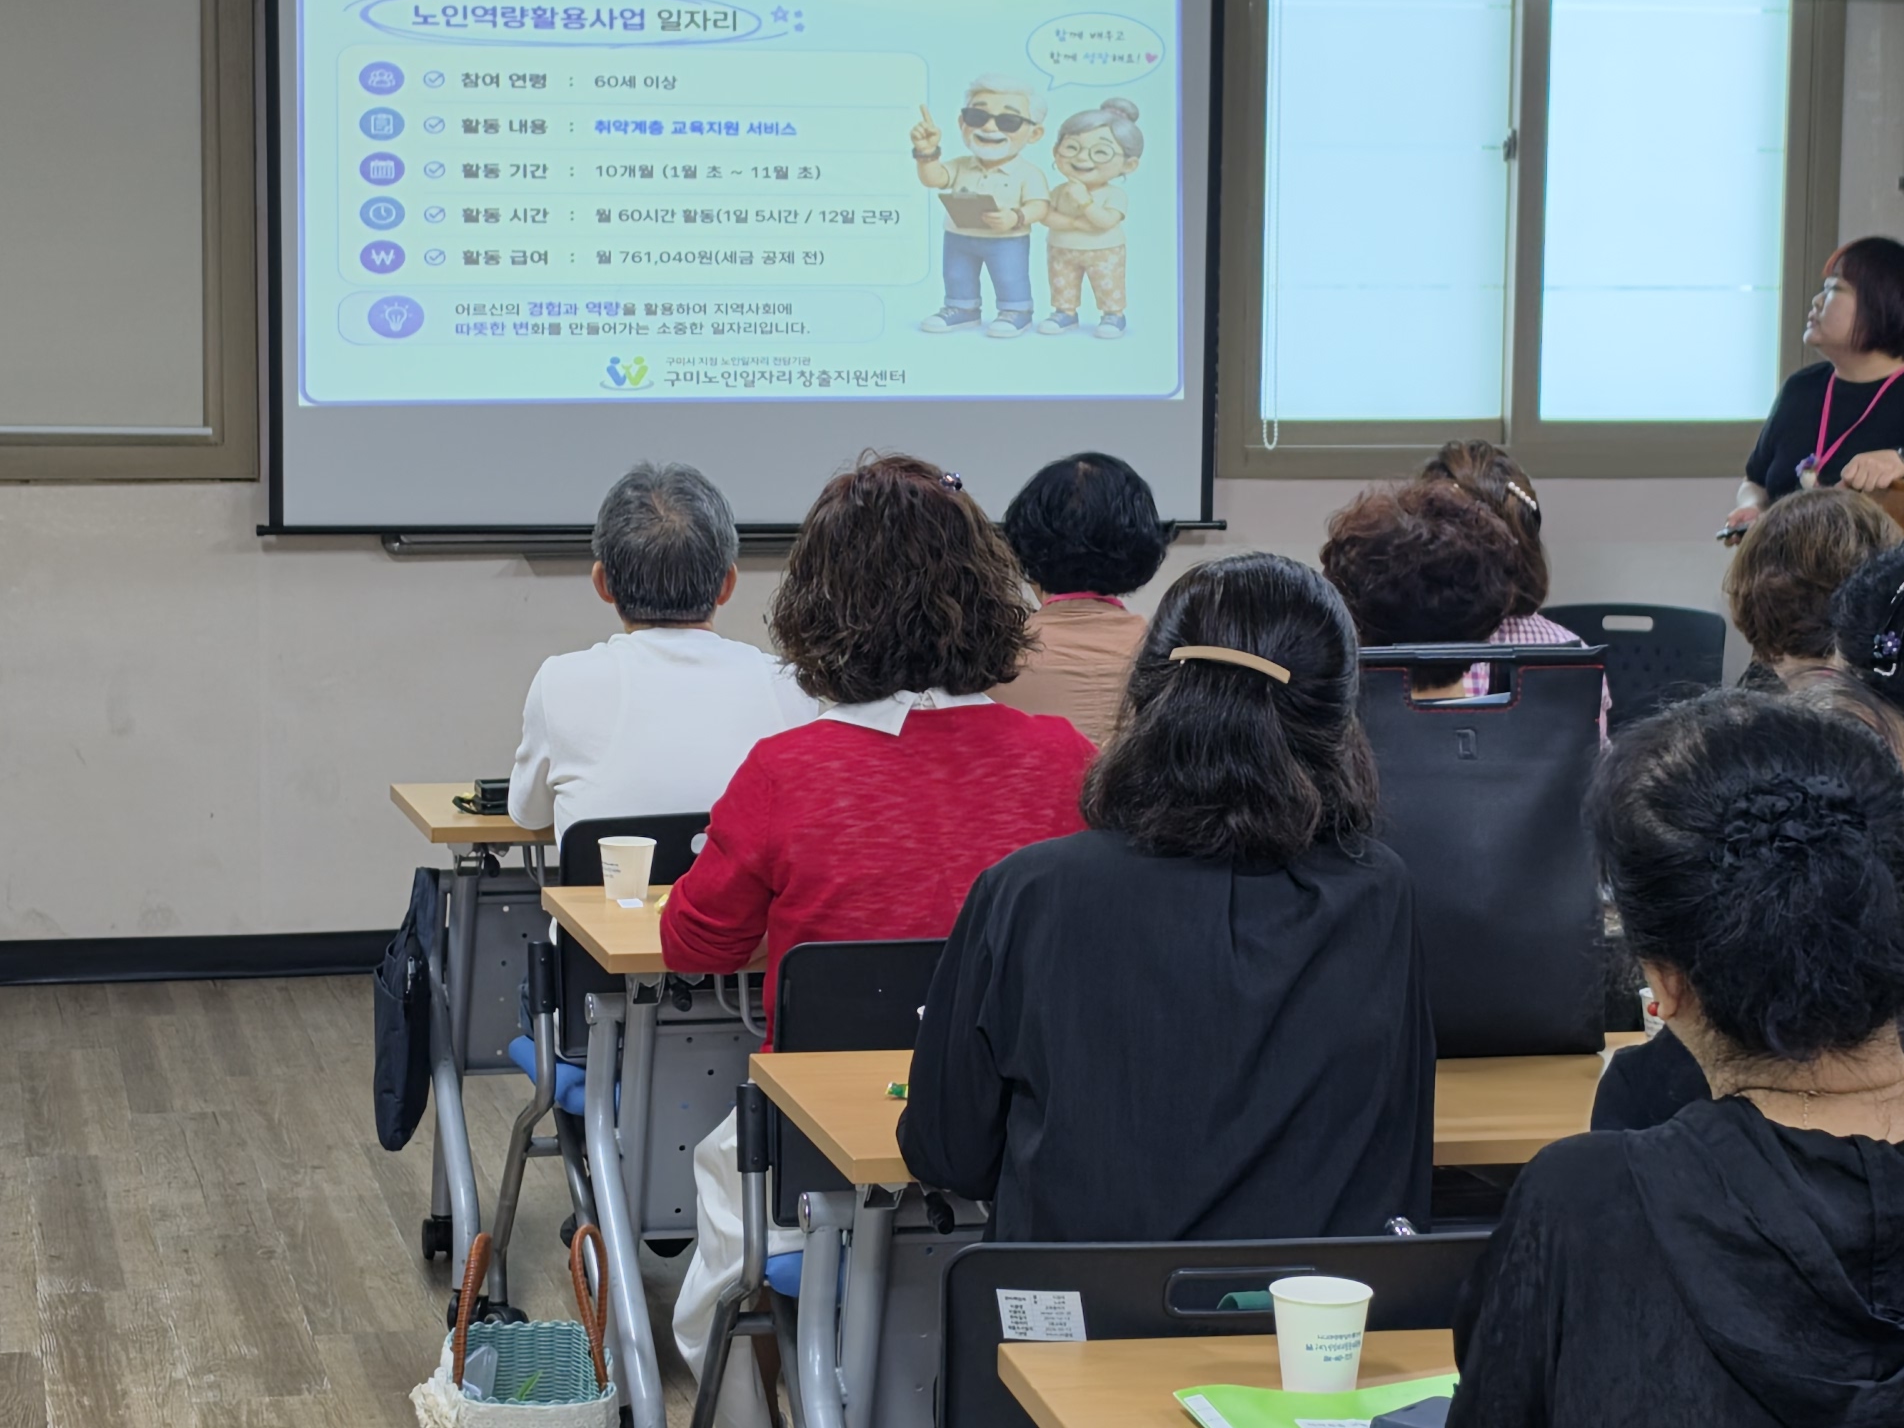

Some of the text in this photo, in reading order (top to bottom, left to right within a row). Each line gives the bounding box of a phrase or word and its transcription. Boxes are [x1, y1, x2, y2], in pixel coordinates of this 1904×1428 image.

[412, 5, 738, 32] 노인역량활용사업 일자리
[462, 72, 499, 88] 참여
[509, 73, 546, 89] 연령
[595, 76, 636, 89] 60세
[644, 76, 677, 90] 이상
[462, 118, 500, 134] 활동
[509, 119, 547, 134] 내용
[595, 120, 664, 135] 취약계층
[671, 121, 739, 136] 교육지원
[747, 122, 797, 136] 서비스
[462, 163, 500, 179] 활동
[510, 164, 548, 179] 기간
[596, 165, 653, 178] 10개월
[663, 164, 697, 179] (1월
[706, 165, 722, 178] 초
[751, 166, 788, 180] 11월
[797, 166, 821, 180] 초)
[462, 208, 501, 223] 활동
[510, 208, 549, 223] 시간
[596, 208, 611, 223] 월
[618, 209, 676, 223] 60시간
[682, 209, 748, 224] 활동(1일
[756, 209, 799, 224] 5시간
[819, 210, 855, 224] 12일
[862, 210, 899, 225] 근무)
[463, 250, 501, 265] 활동
[510, 250, 548, 265] 급여
[596, 250, 611, 264] 월
[762, 251, 794, 264] 공제
[803, 251, 824, 265] 전)
[455, 301, 792, 316] 어르신의 경험과 역량을 활용하여 지역사회에
[455, 321, 810, 336] 따뜻한 변화를 만들어가는 소중한 일자리입니다.
